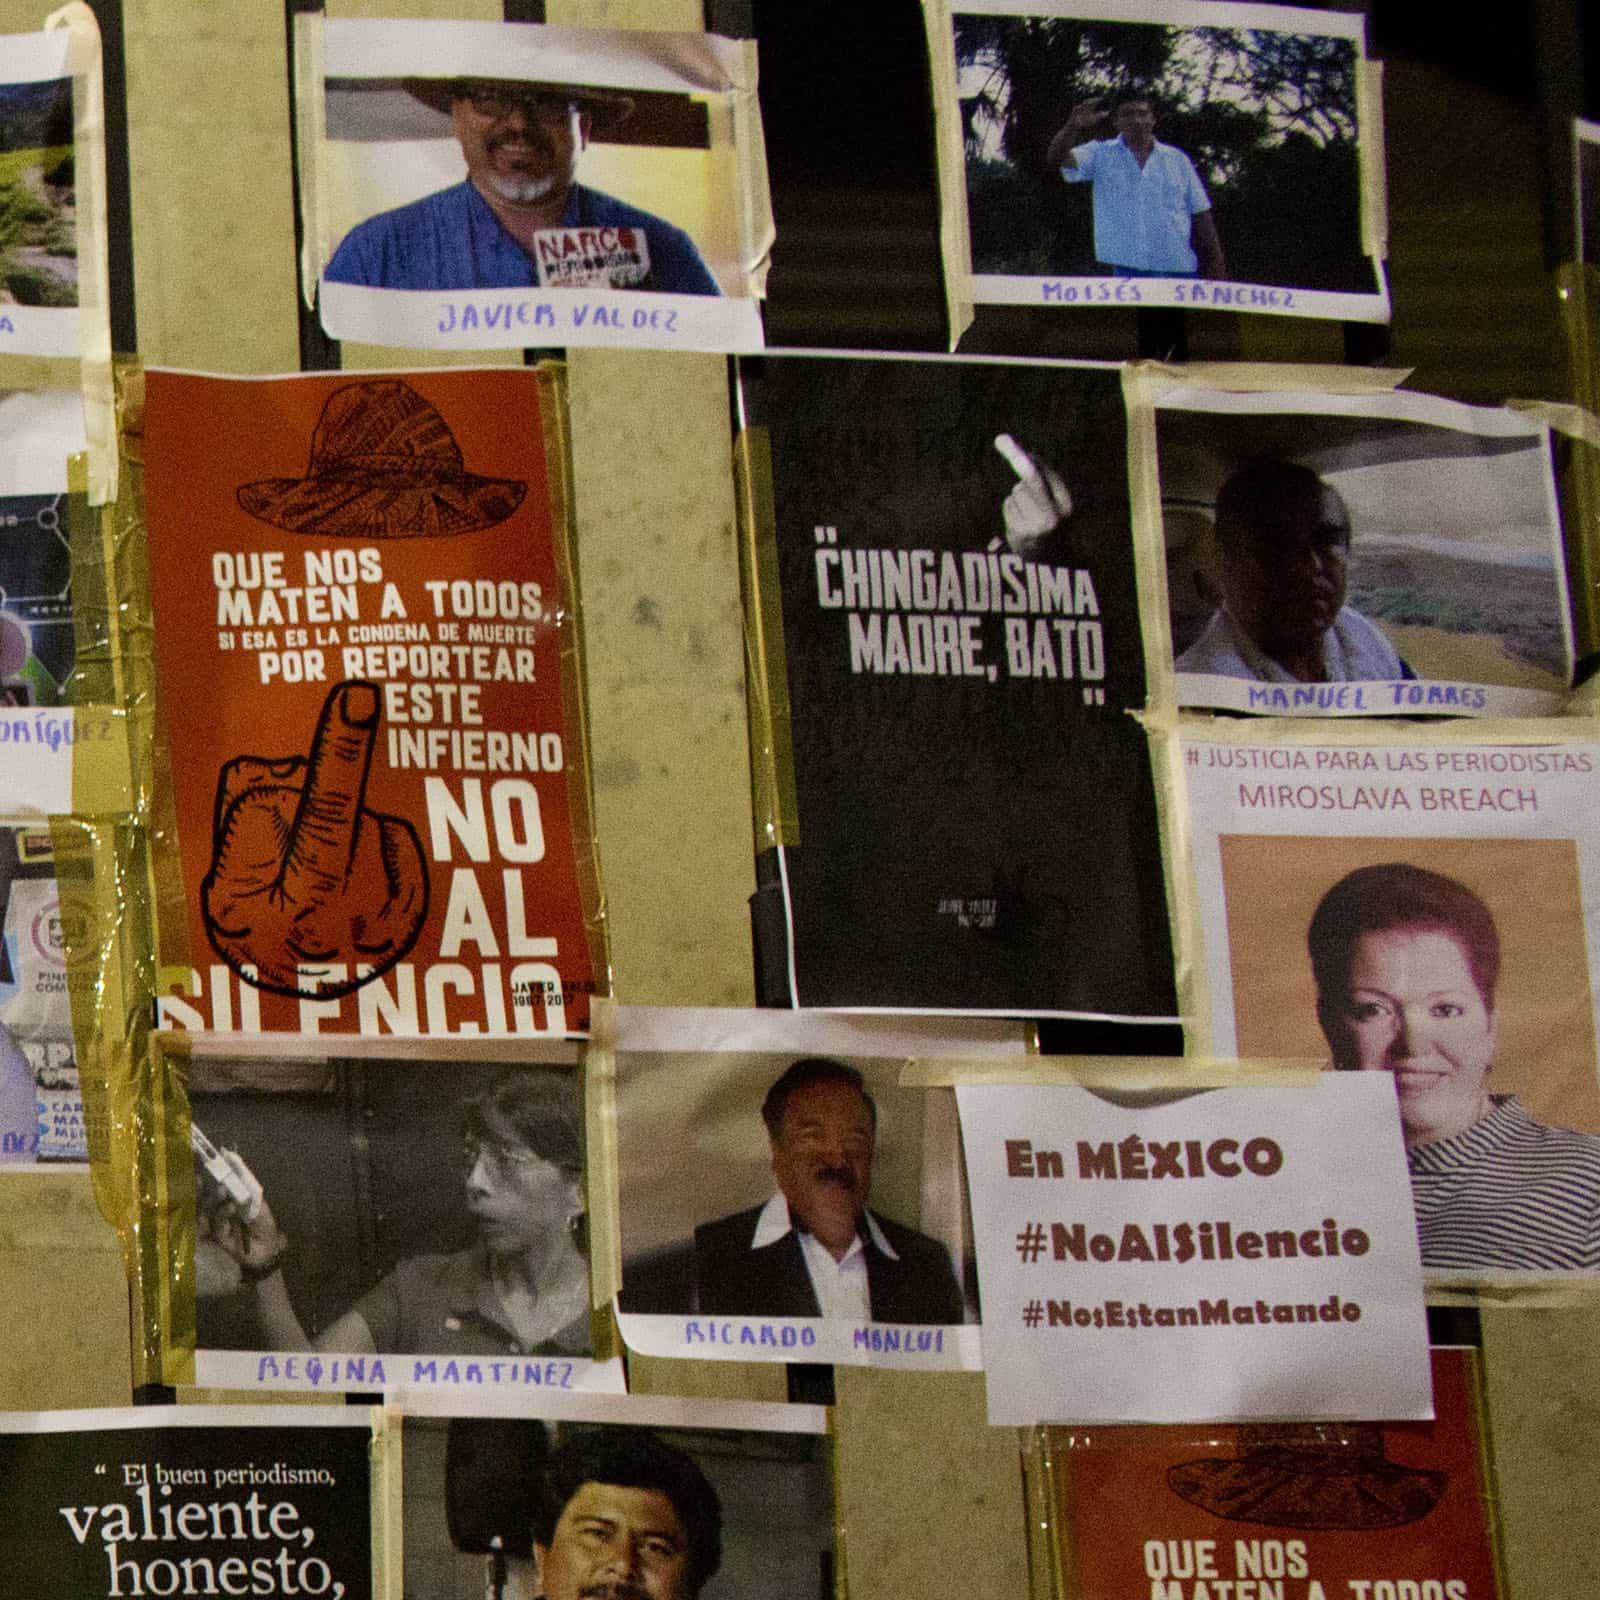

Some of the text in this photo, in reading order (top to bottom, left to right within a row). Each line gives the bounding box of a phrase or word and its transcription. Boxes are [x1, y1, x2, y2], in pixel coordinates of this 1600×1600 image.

[437, 302, 678, 334] JAVIER VALDEZ
[212, 547, 382, 590] QUE NOS
[217, 583, 359, 626] MATEN
[258, 644, 536, 686] POR REPORTEAR
[848, 613, 999, 684] MADRE,
[384, 682, 483, 726] ESTE
[1247, 682, 1487, 710] MANUEL TORRES
[387, 728, 564, 773] INFIERNO
[1316, 750, 1378, 771] PARA
[1386, 751, 1429, 772] LAS
[1436, 752, 1592, 774] PERIODISTAS
[1238, 783, 1539, 813] MIROSLAVA BREACH
[423, 776, 546, 864] NO
[438, 866, 559, 958] AL
[157, 962, 568, 1037] SILENCIO
[1005, 1133, 1284, 1181] En MÉXICO
[1016, 1218, 1371, 1265] #NoAlSilencio
[686, 1321, 818, 1348] RICARDO
[1023, 1296, 1362, 1330] #NosEstanMatando
[257, 1355, 574, 1389] REGINA MARTINEZ
[155, 1462, 336, 1489] buen periodismo,
[59, 1483, 316, 1549] valiente,
[1144, 1539, 1309, 1580] QUE NOS
